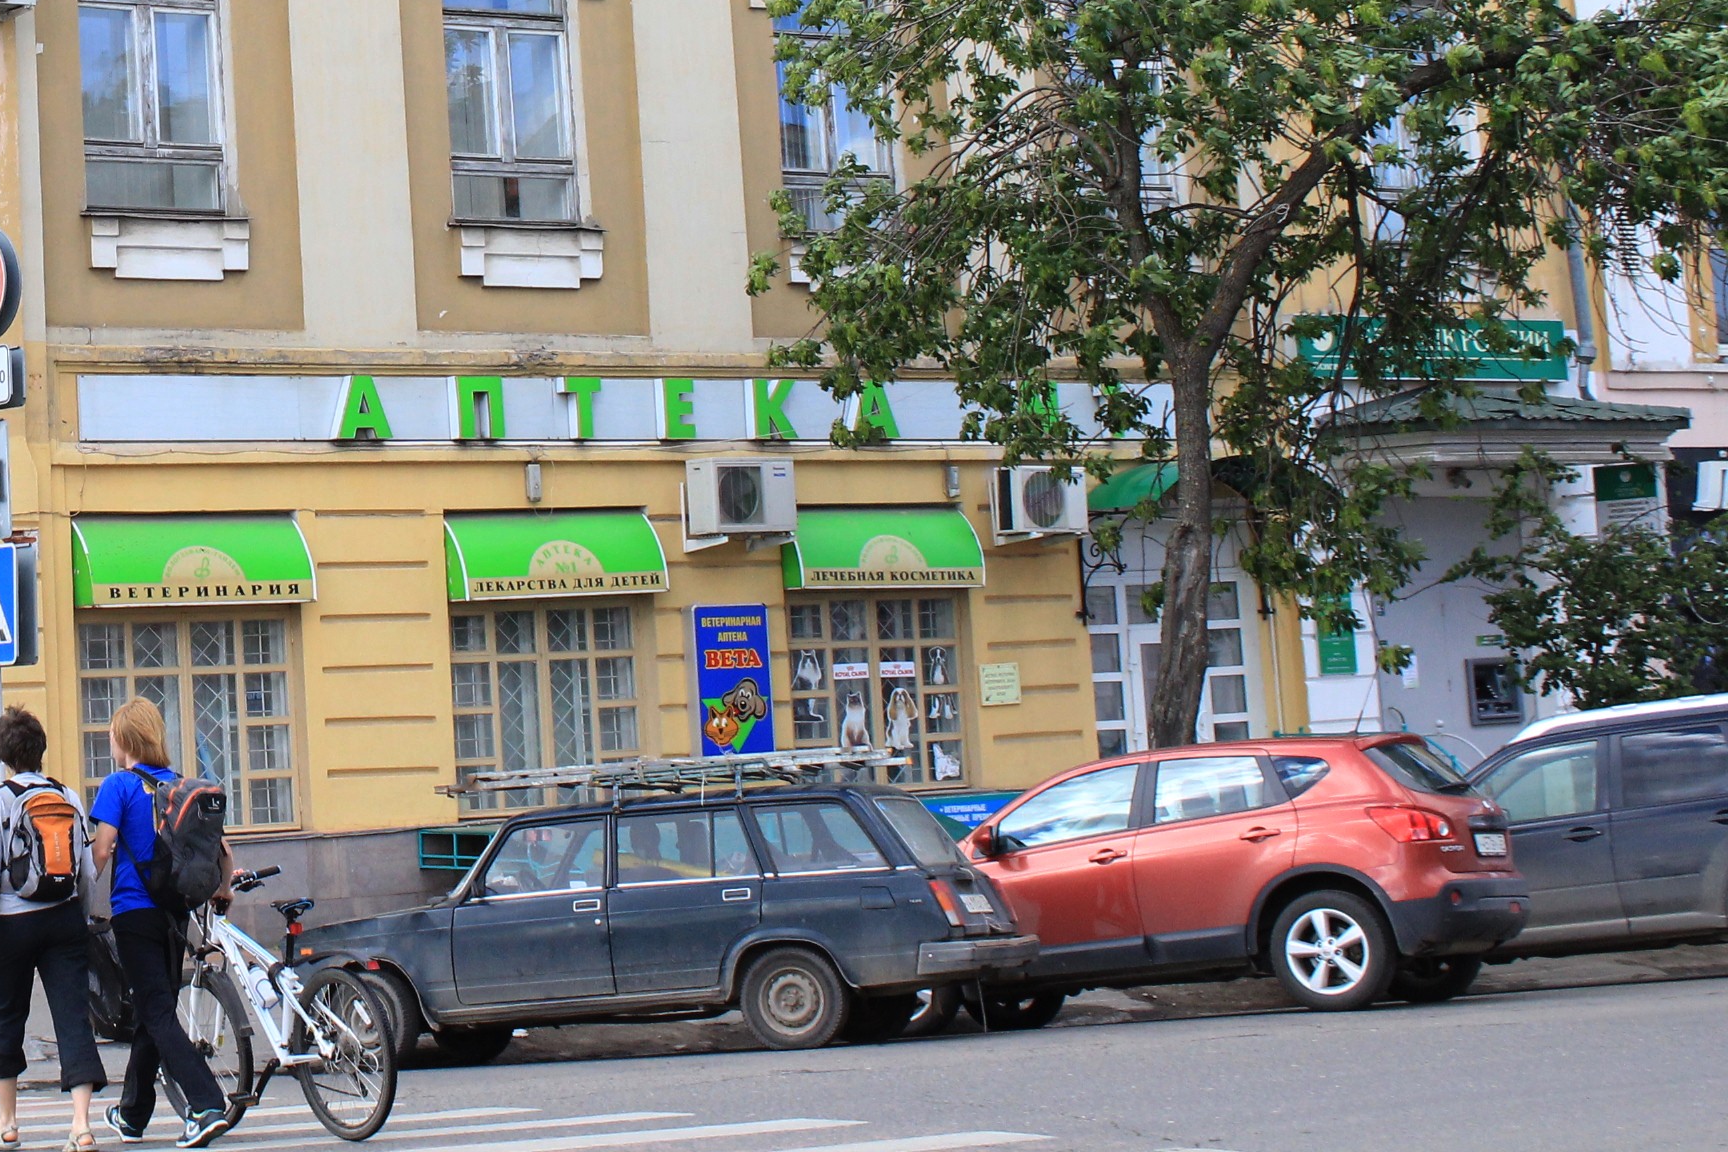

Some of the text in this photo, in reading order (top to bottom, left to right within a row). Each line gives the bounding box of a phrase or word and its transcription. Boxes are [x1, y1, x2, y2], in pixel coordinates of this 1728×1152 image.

[335, 375, 901, 440] АПТЕКА
[535, 544, 592, 568] АПТЕКА
[474, 573, 661, 593] ЛЕКАРСТВА ДЛЯ ДЕТЕЙ
[811, 570, 976, 582] ЛЕЧЕБНАЯ КОСМЕТИКА
[109, 583, 300, 599] ВЕТЕРИНАРИЯ
[700, 615, 762, 628] ВЕТЕРИНАРНАЯ
